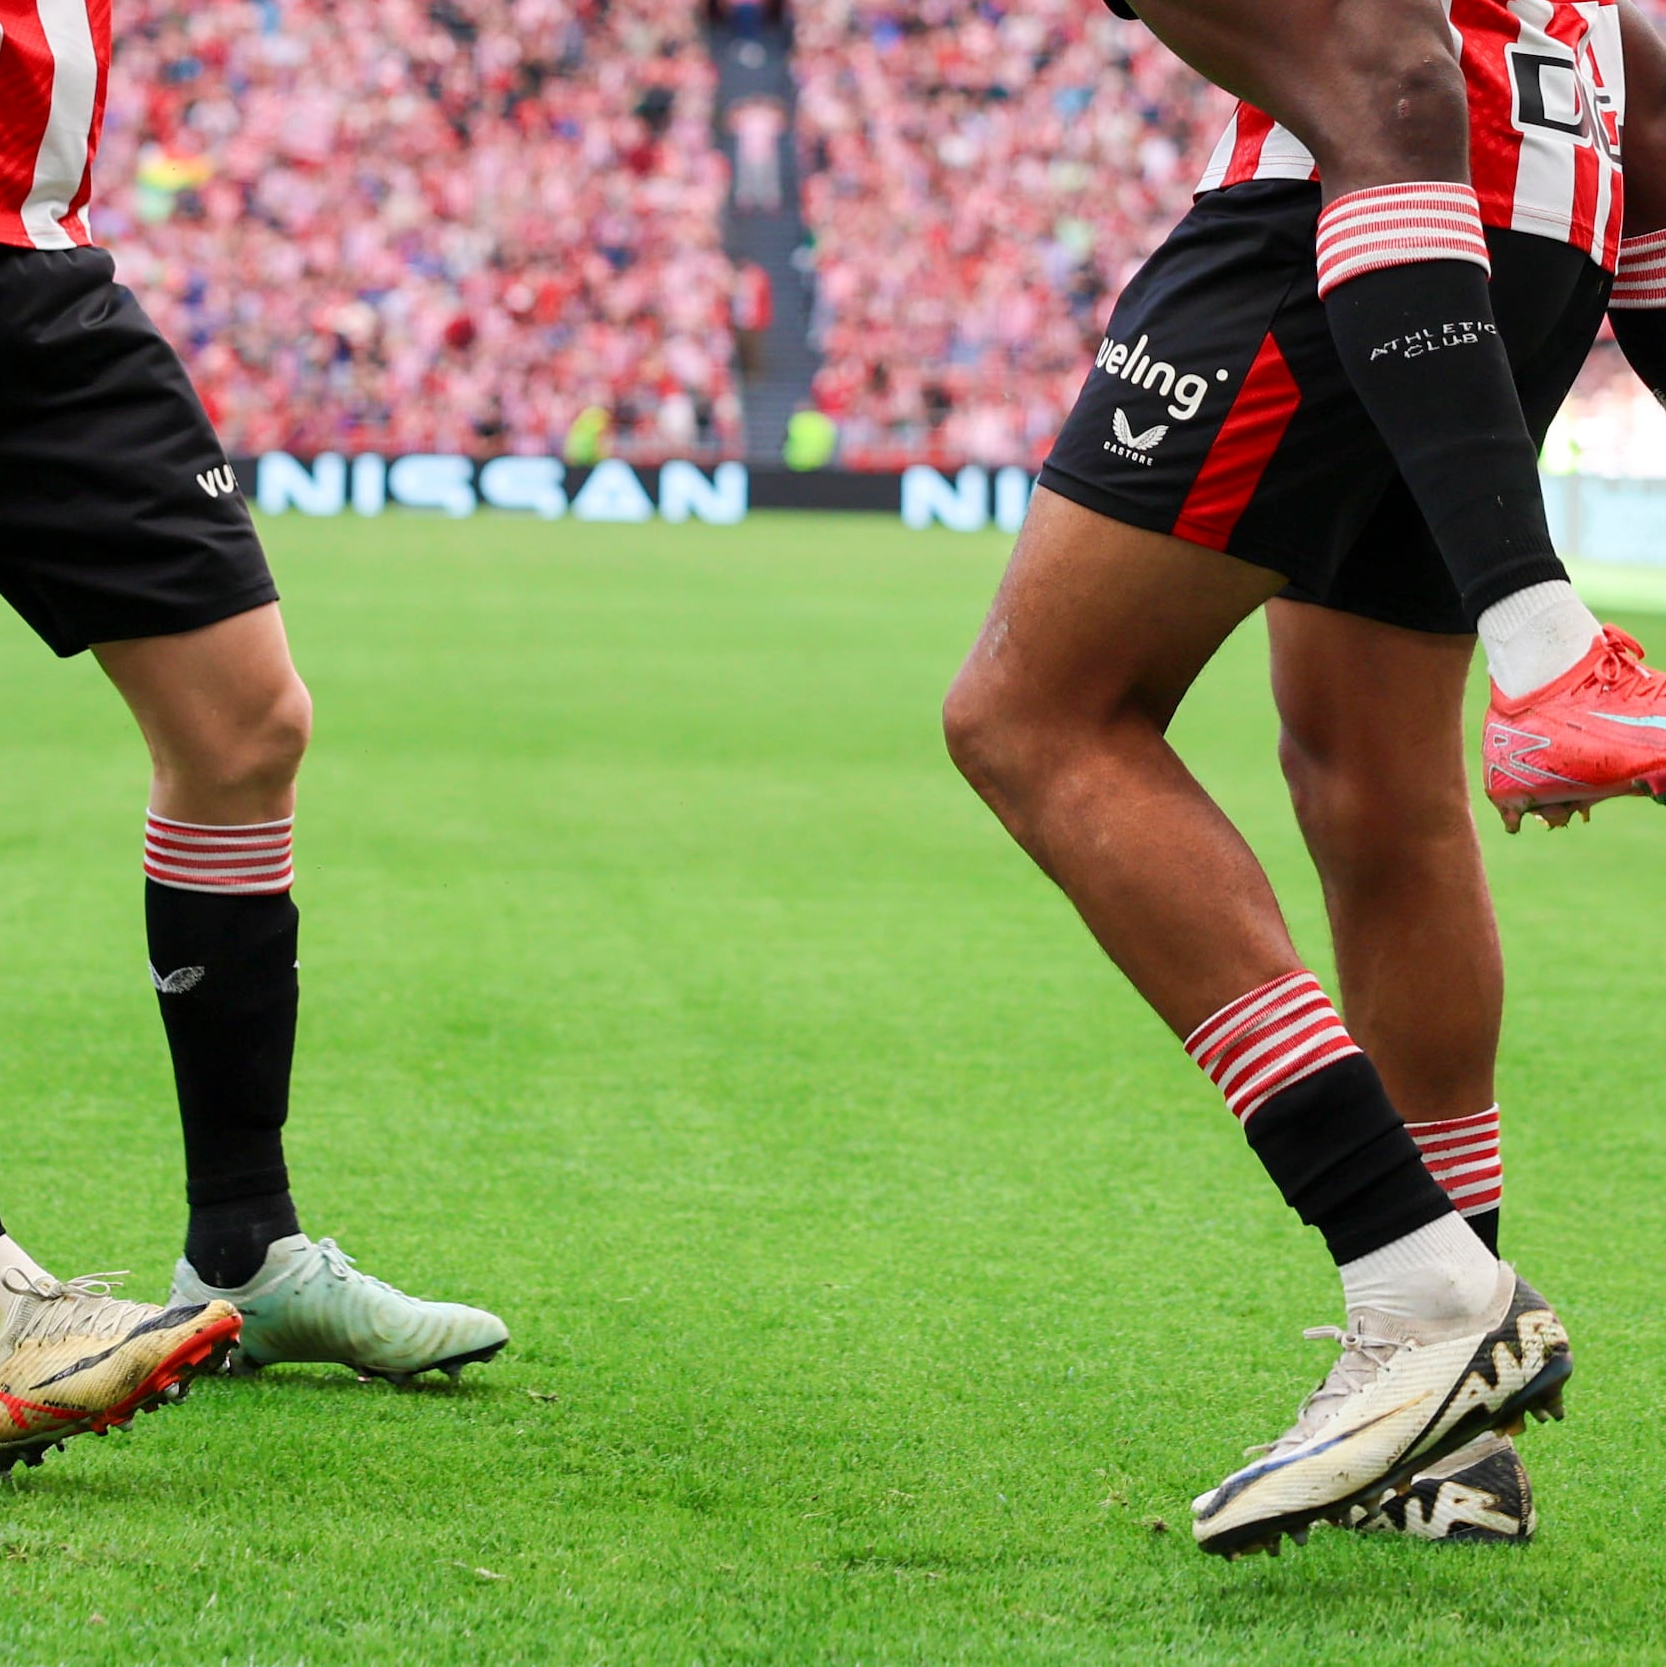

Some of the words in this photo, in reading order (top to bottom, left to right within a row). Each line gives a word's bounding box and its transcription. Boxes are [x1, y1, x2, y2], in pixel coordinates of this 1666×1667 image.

[1404, 332, 1479, 359] CLUB
[1103, 440, 1155, 467] CASTORE
[256, 450, 748, 525] NISSAN
